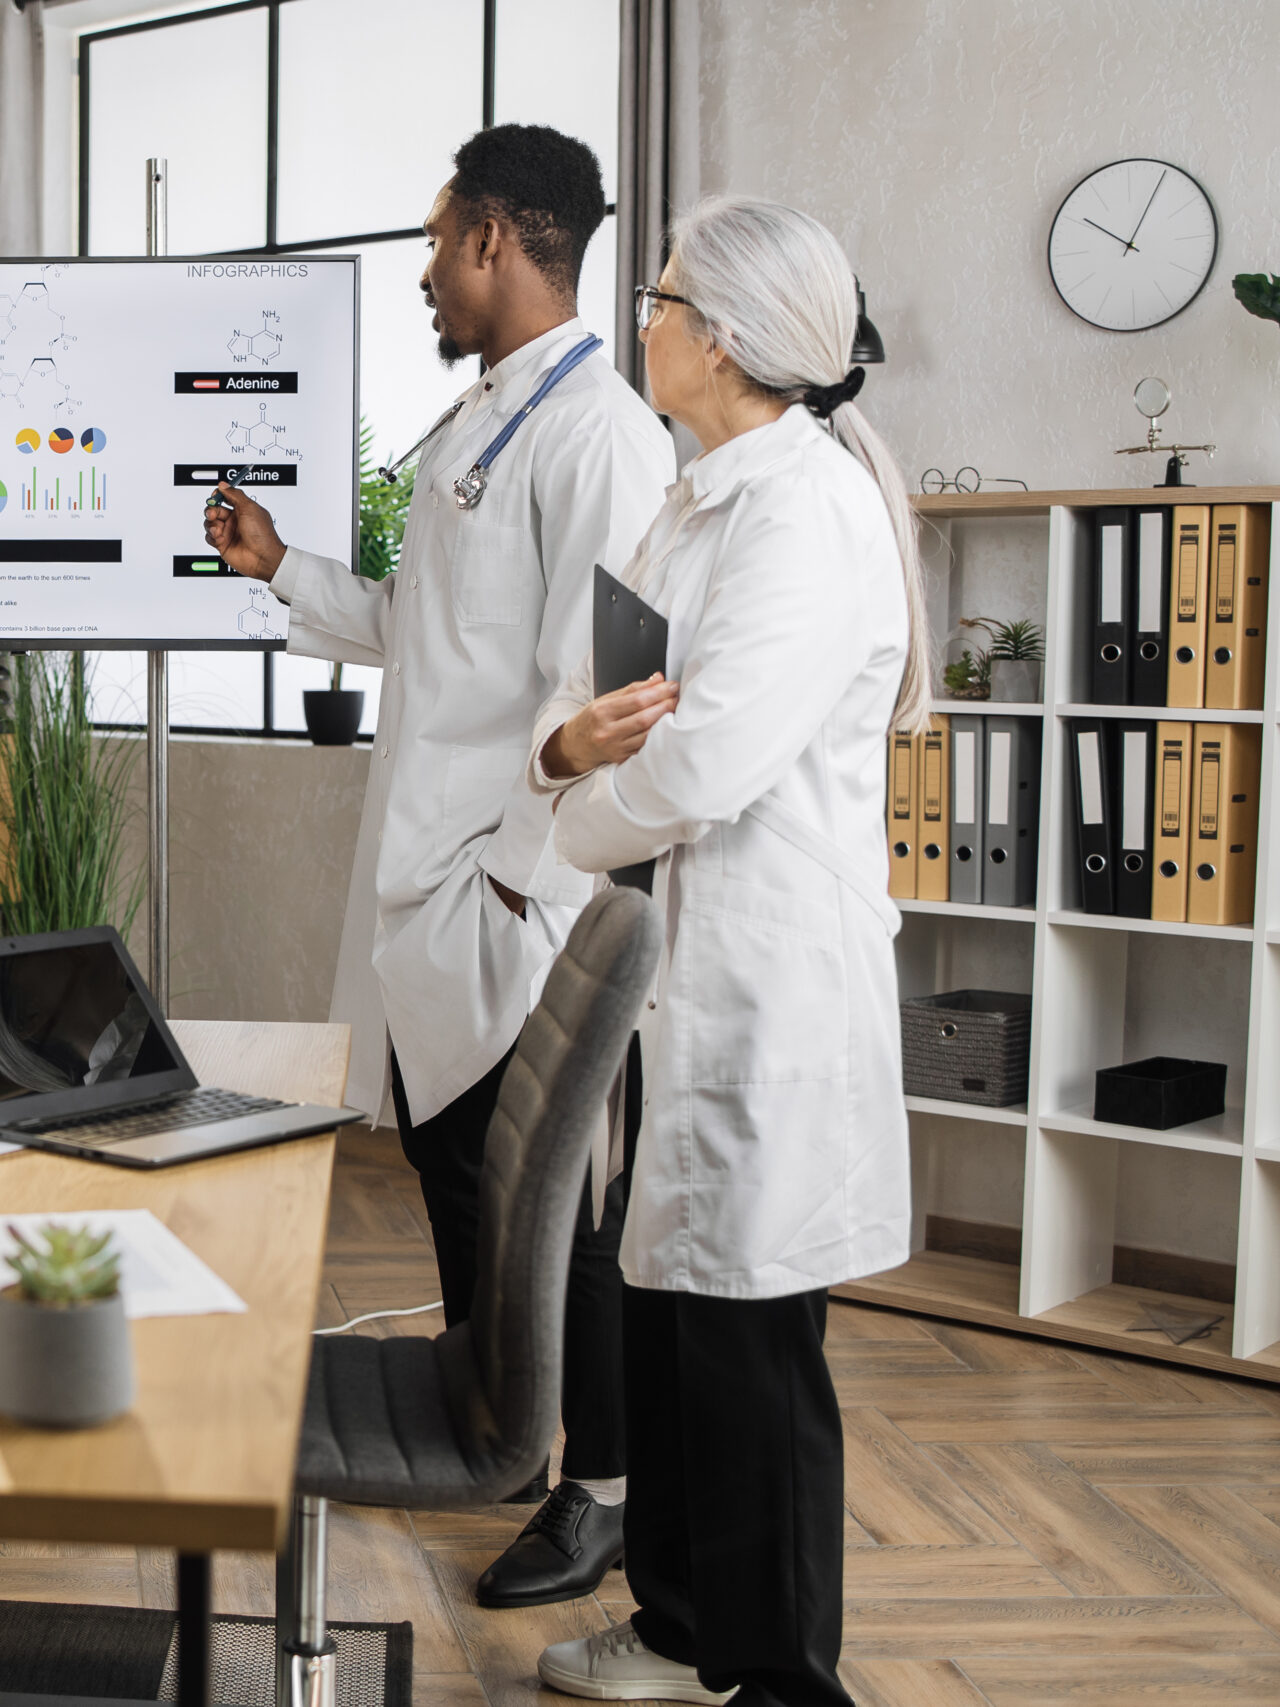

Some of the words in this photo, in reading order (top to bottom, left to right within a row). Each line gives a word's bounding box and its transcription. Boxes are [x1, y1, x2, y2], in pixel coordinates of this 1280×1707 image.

[187, 264, 308, 277] INFOGRAPHICS
[233, 329, 240, 337] N
[226, 377, 280, 390] Adenine
[259, 402, 266, 410] O
[226, 468, 280, 480] Ganine
